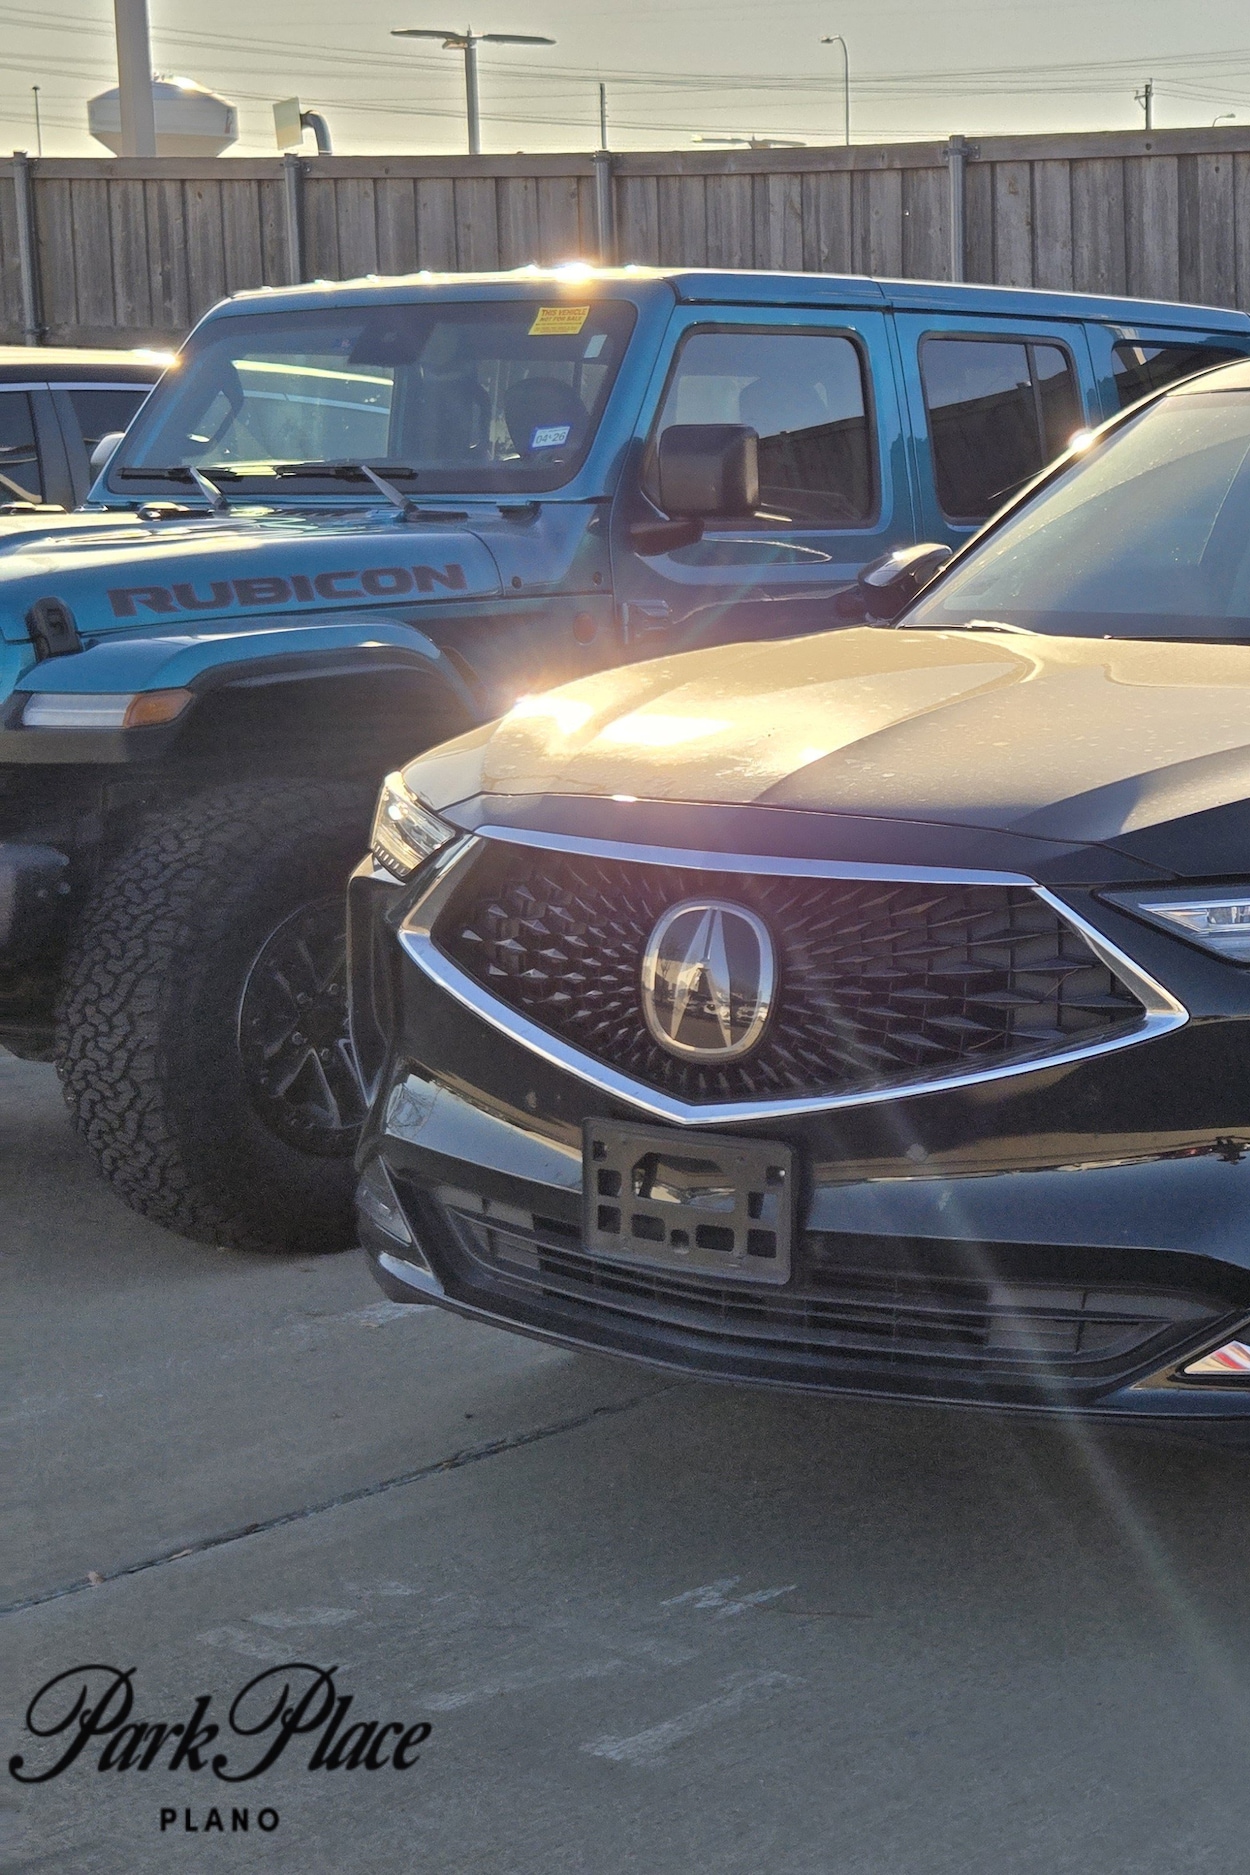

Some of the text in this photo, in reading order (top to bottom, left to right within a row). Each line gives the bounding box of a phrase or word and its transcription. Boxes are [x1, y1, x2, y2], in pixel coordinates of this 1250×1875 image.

[541, 307, 587, 317] THIS VEHICLE
[107, 563, 468, 618] RUBICON
